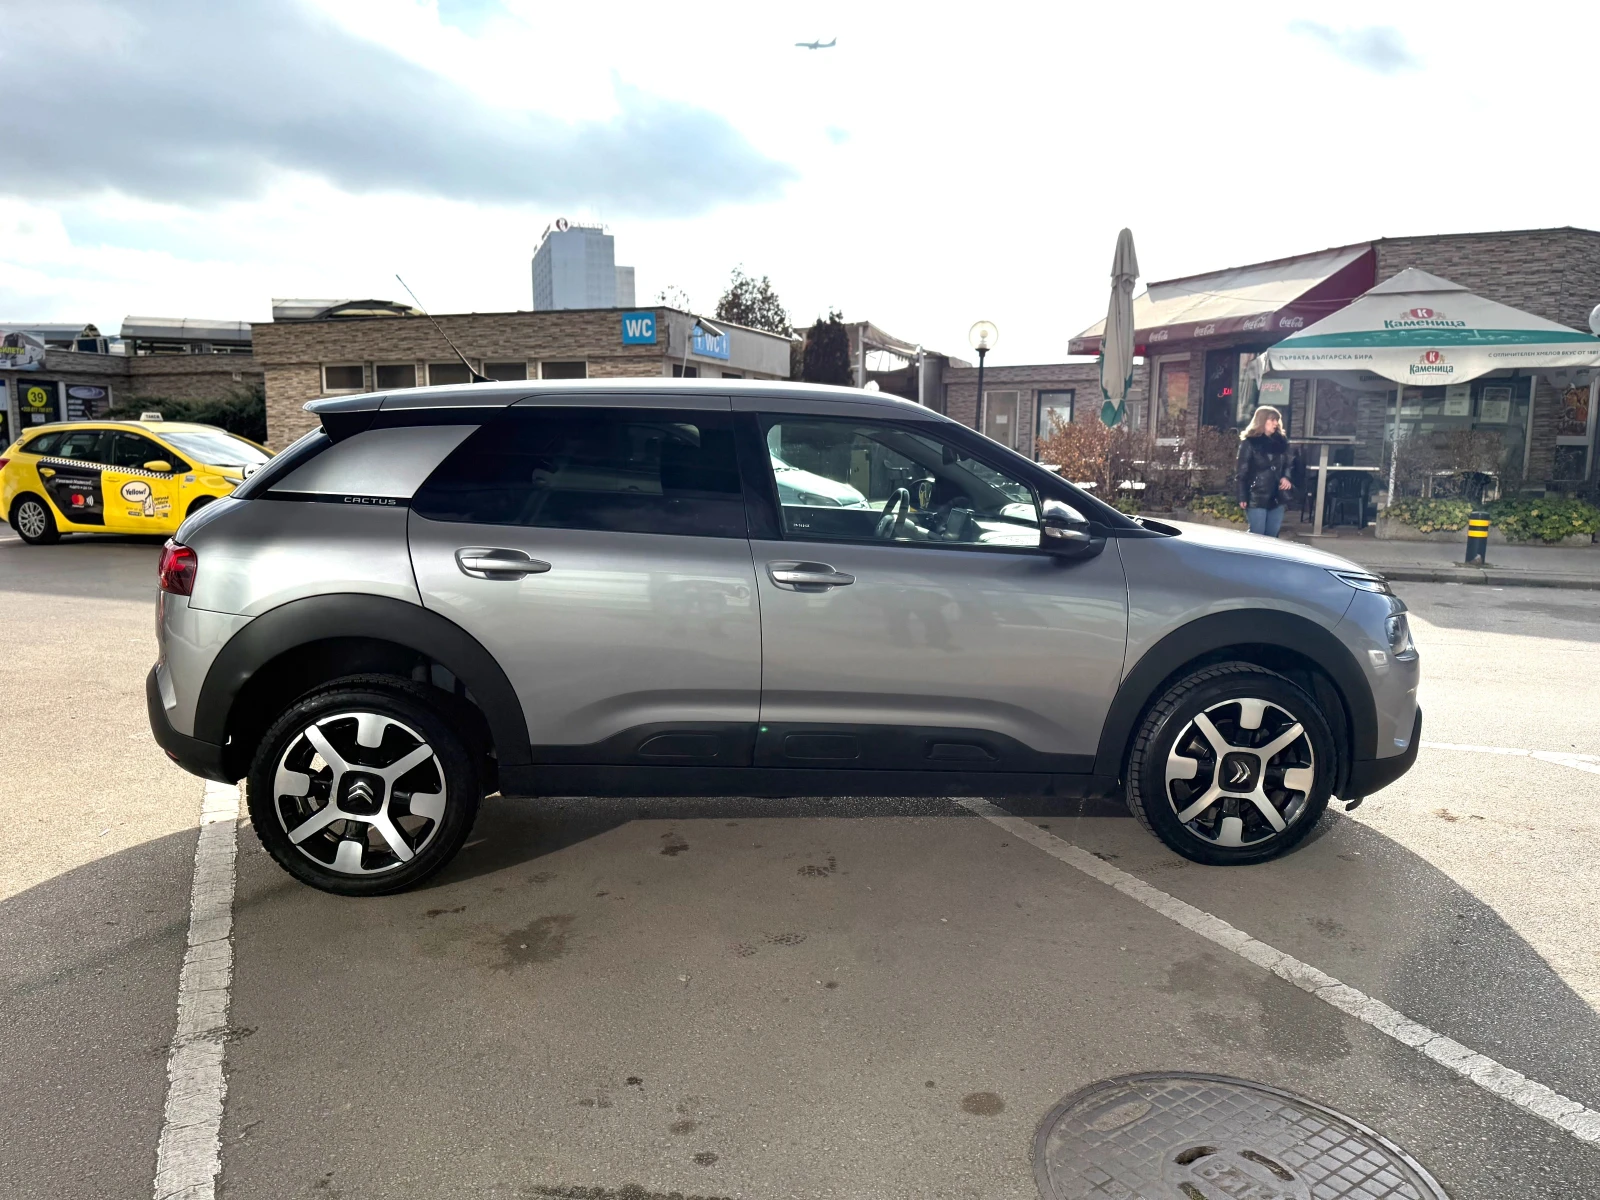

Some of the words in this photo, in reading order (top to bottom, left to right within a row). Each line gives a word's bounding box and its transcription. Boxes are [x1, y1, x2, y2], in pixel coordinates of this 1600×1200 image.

[625, 319, 652, 337] WC
[1383, 320, 1466, 329] Каменица
[705, 332, 720, 353] WC
[1409, 364, 1454, 375] Каменица
[30, 391, 44, 403] 39
[344, 496, 397, 505] CACTUS
